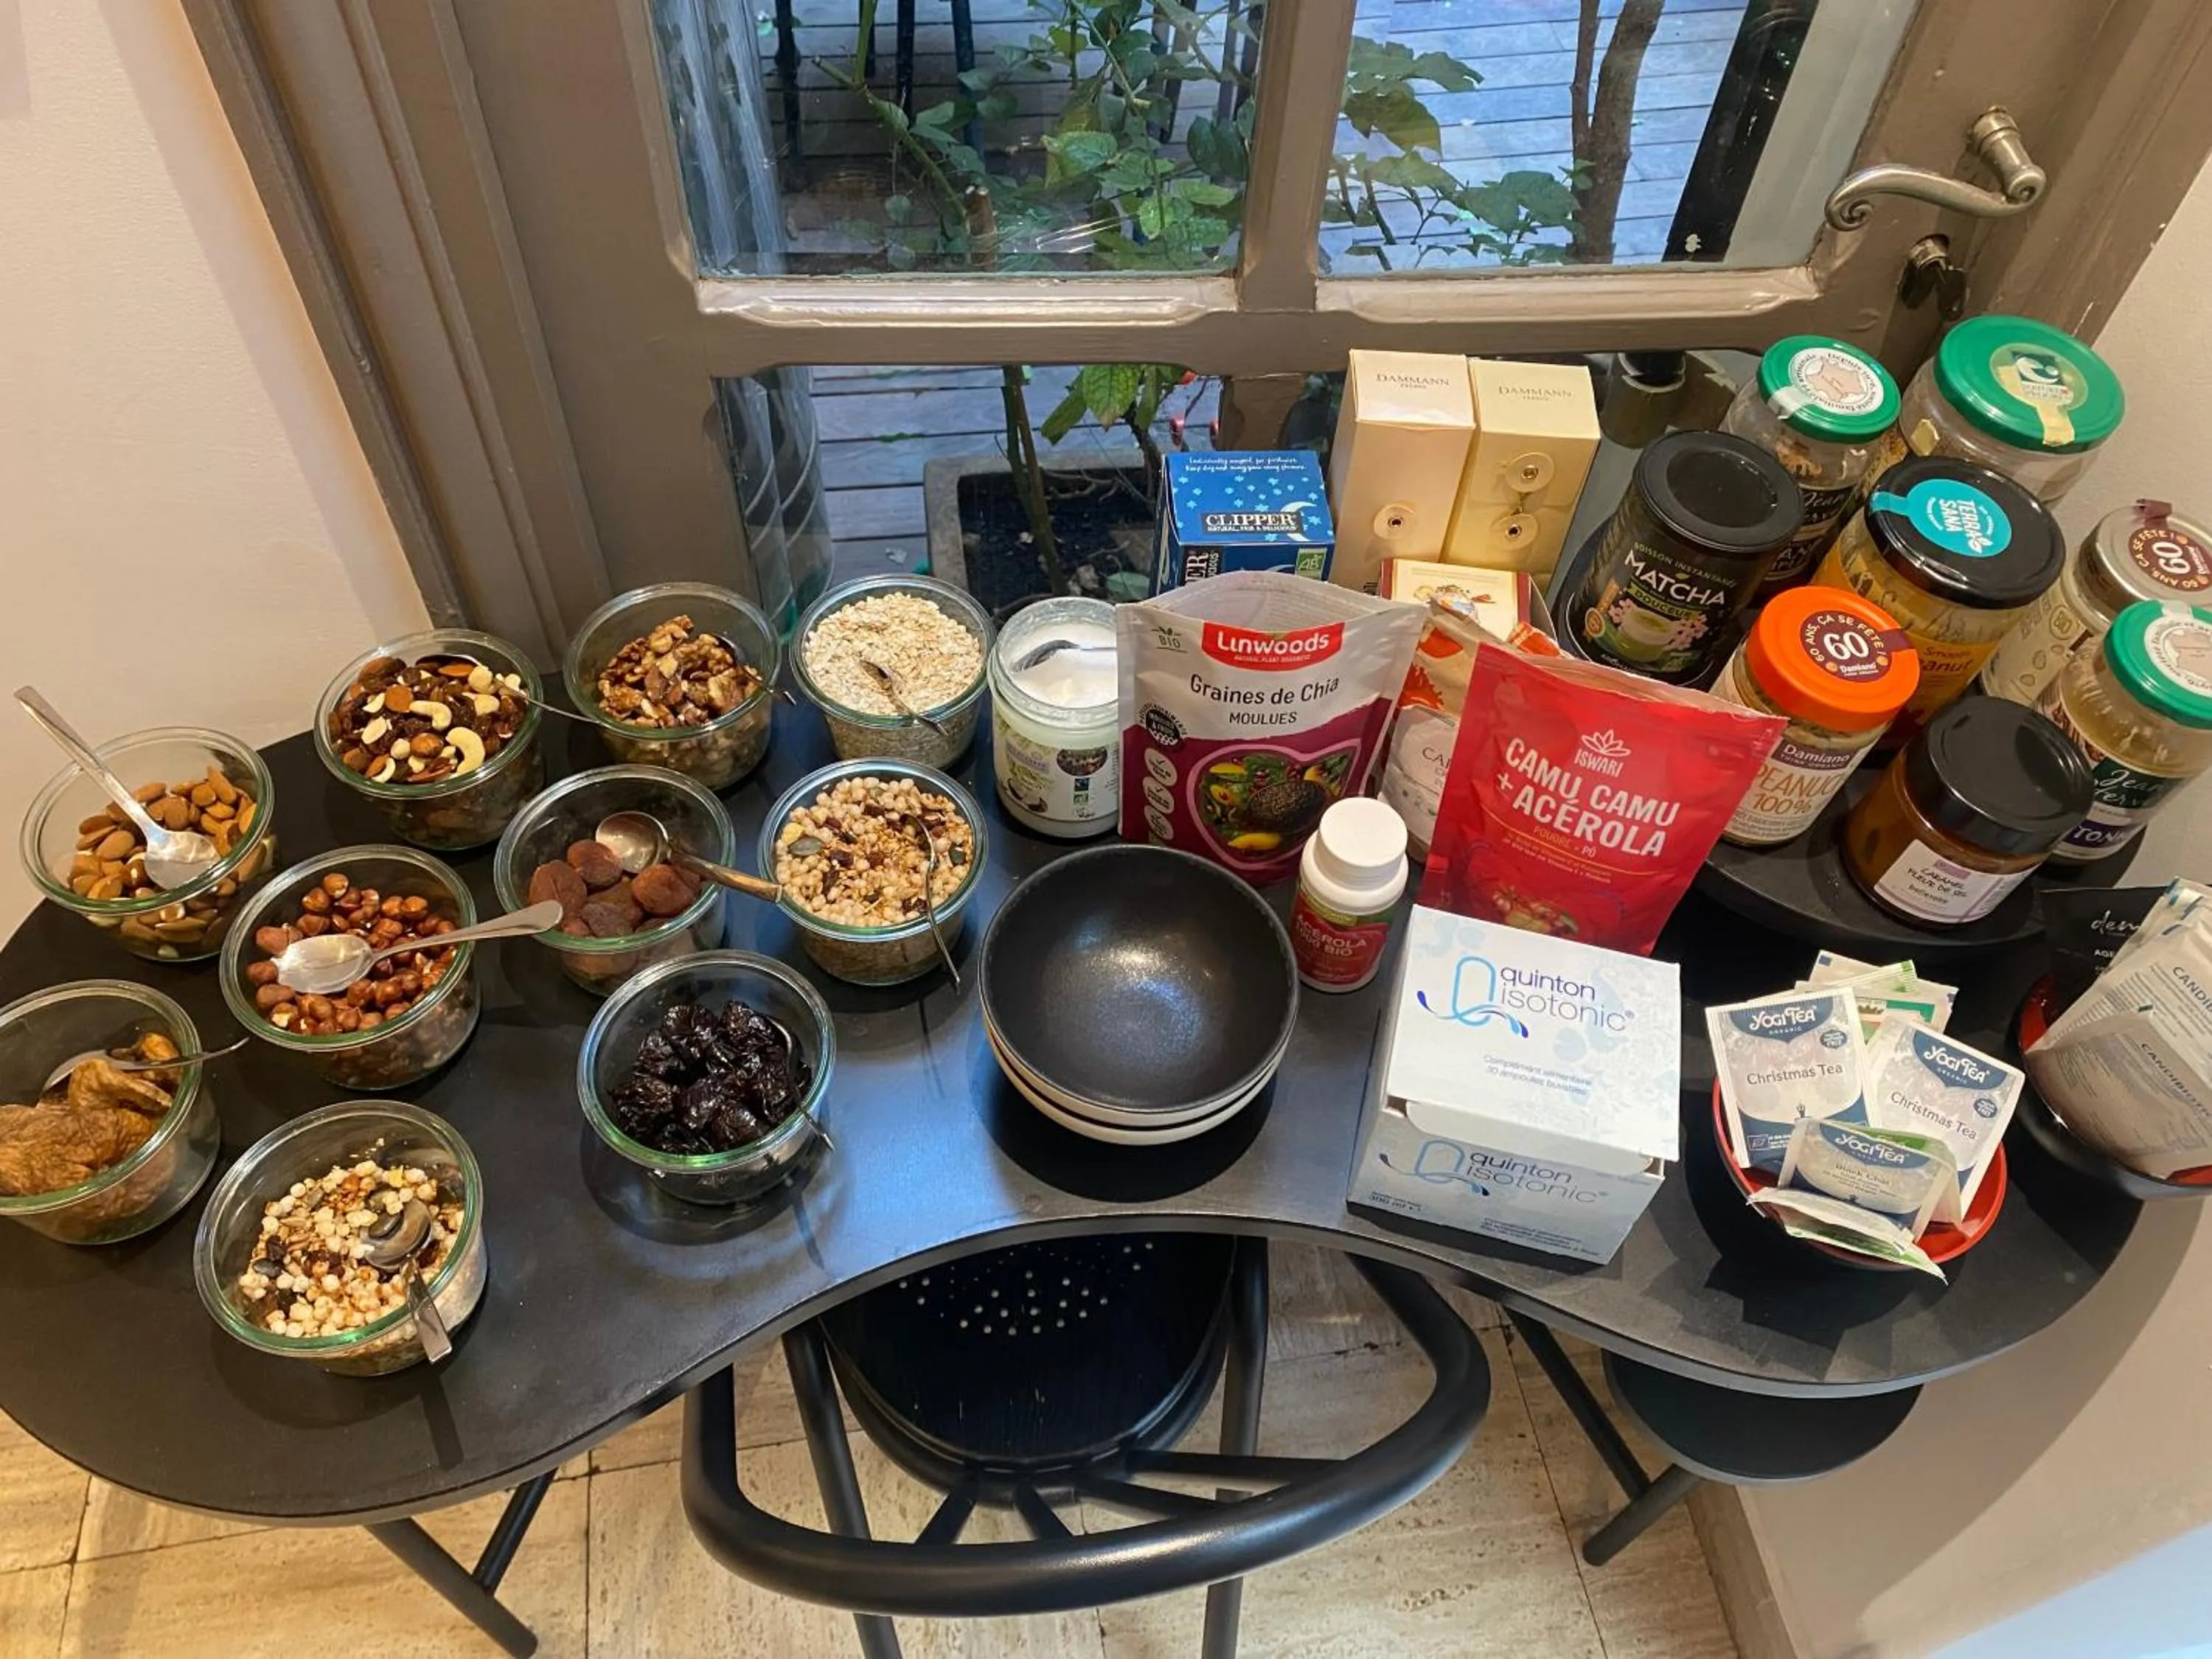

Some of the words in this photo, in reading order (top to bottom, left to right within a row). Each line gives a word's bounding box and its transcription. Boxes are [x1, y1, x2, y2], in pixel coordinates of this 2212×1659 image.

[1376, 373, 1450, 386] DAMMANN
[1498, 386, 1572, 397] DAMMANN
[1206, 514, 1295, 526] CLIPPER
[1939, 499, 1964, 532] SANA
[1956, 499, 1983, 538] TERRA
[1633, 543, 1673, 565] BOISSON
[2152, 541, 2191, 574] 60
[1624, 549, 1725, 605] MATCHA
[1635, 590, 1691, 619] DOUCEUR
[1159, 636, 1180, 648] BIO
[1217, 631, 1330, 655] Linwoods
[1810, 648, 1825, 661] 60
[1838, 614, 1854, 625] SE
[1823, 632, 1869, 660] 60
[1190, 673, 1265, 704] Graines
[1270, 688, 1295, 704] de
[1301, 678, 1340, 701] Chia
[1229, 712, 1298, 725] MOULUES
[1574, 748, 1624, 778] ISWARI
[1784, 744, 1850, 764] Damiano
[1505, 737, 1582, 799] CAMU
[1590, 785, 1680, 827] CAMU
[1753, 793, 1812, 815] 100%
[1513, 785, 1667, 857] ACÉROLA
[1324, 945, 1352, 956] BIO
[1500, 967, 1595, 1001] quinton
[1747, 1067, 1816, 1085] Christmas
[1818, 1064, 1843, 1076] Tea
[1891, 1091, 1953, 1128] Christmas
[1956, 1121, 1977, 1139] Tea
[1470, 1152, 1572, 1183] quinton
